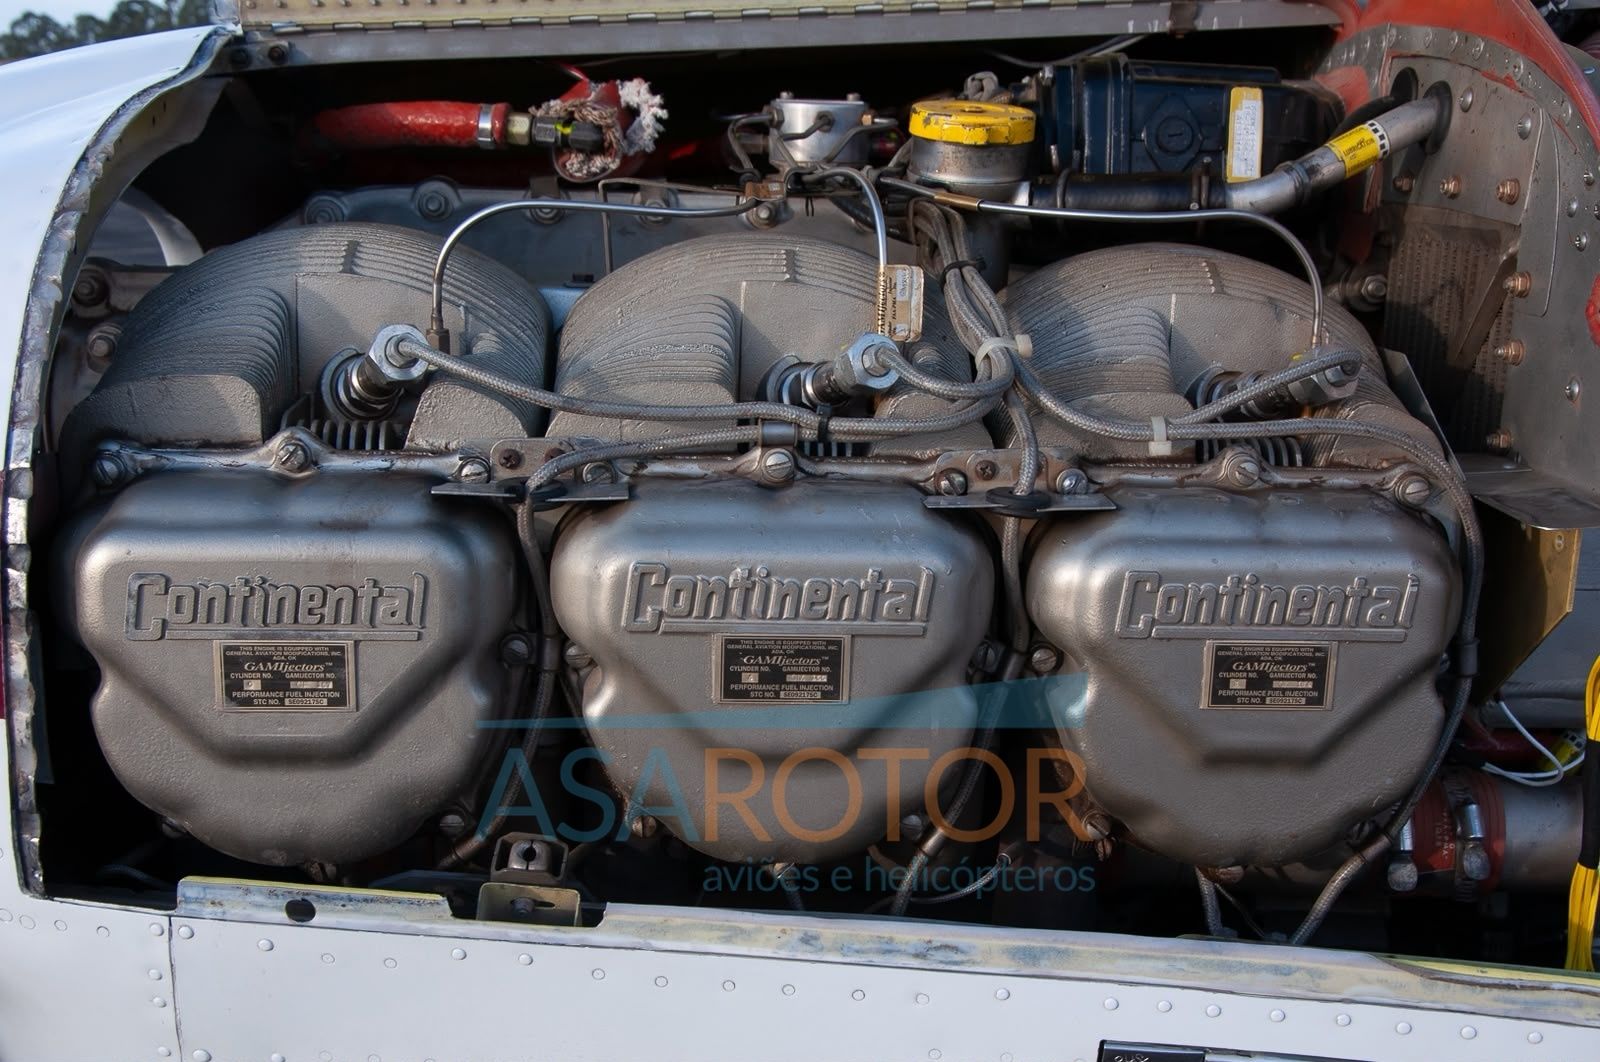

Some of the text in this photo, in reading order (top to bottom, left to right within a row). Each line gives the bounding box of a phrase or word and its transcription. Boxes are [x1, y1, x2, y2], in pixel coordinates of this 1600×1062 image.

[124, 572, 426, 641] Continental
[621, 559, 936, 632] Continental
[1114, 569, 1421, 639] Continental
